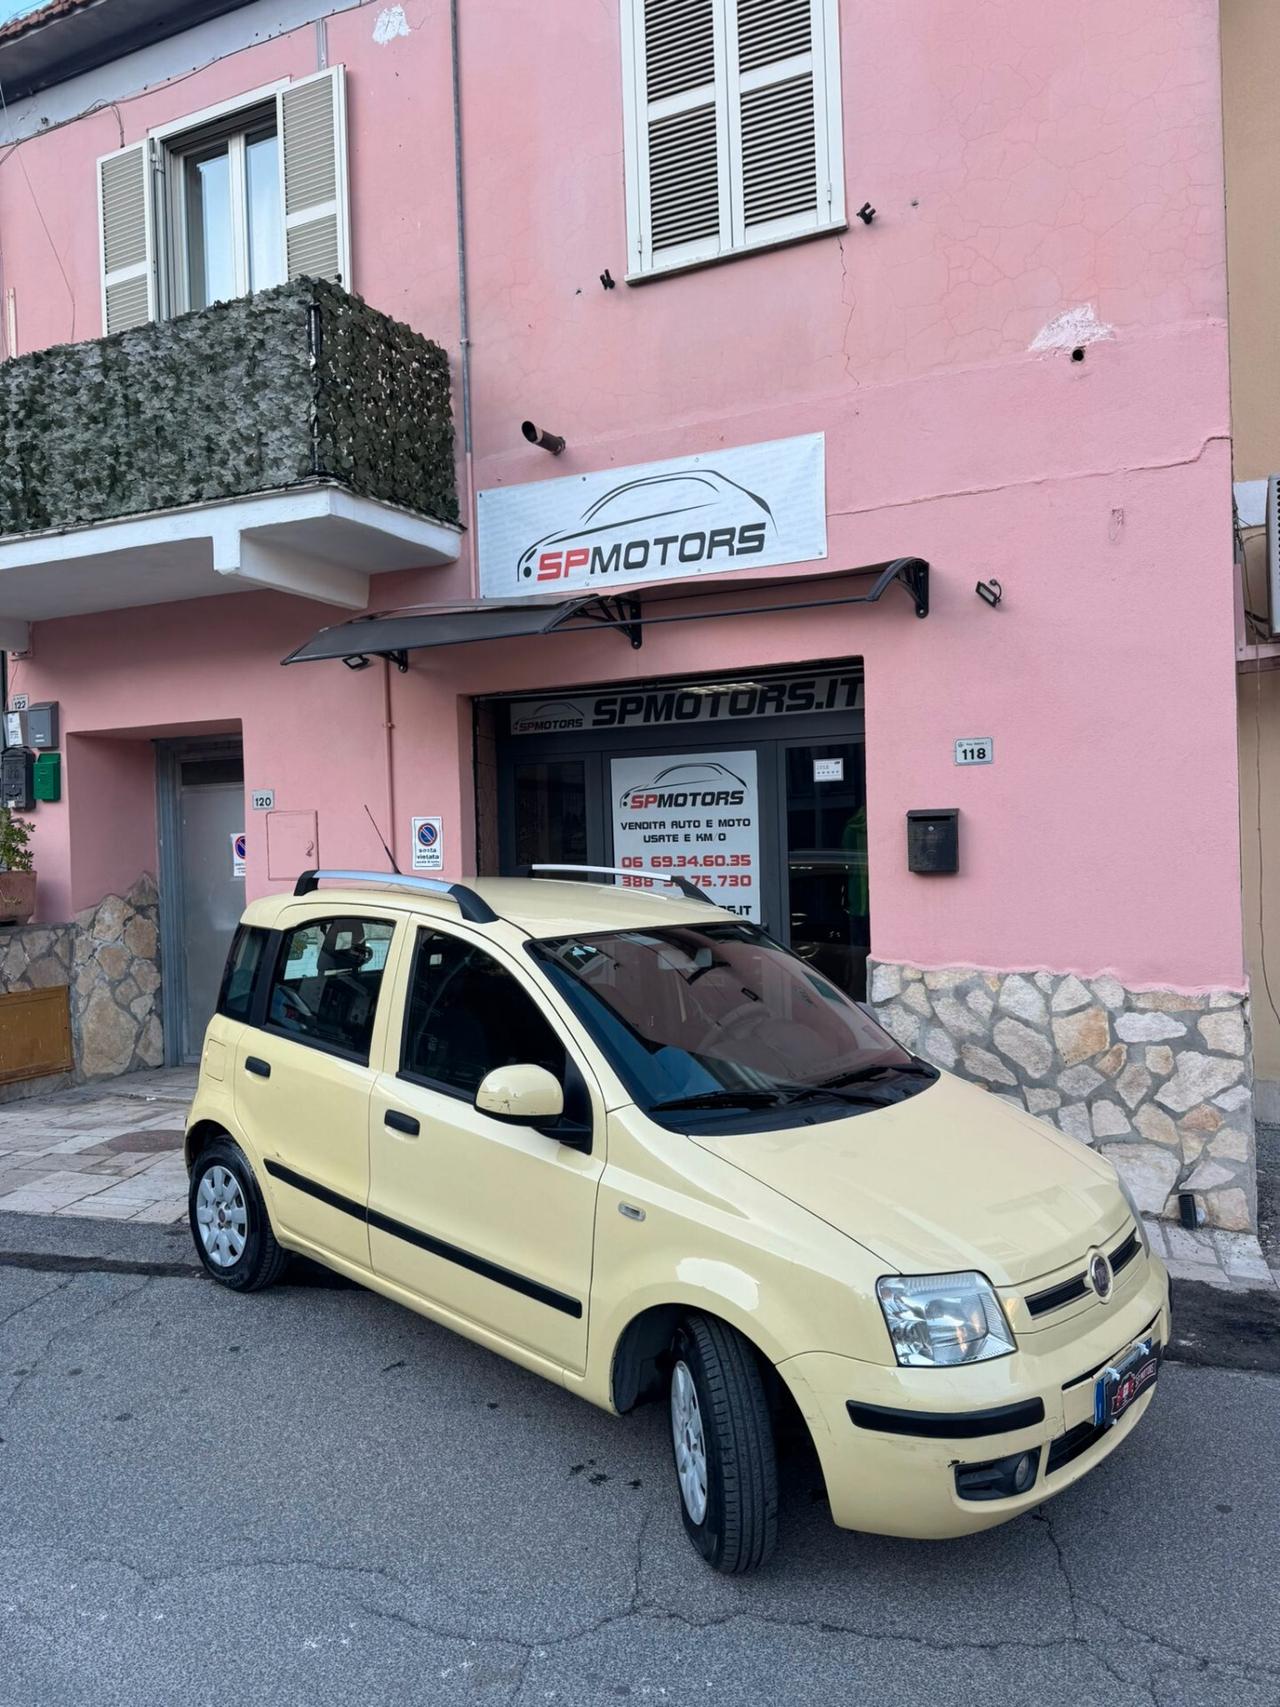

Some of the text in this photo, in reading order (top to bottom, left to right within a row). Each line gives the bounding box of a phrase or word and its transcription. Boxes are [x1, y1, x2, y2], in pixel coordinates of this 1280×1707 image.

[537, 522, 766, 581] SPMOTORS
[592, 678, 864, 727] SPMOTORS.IT
[962, 747, 986, 760] 118
[255, 797, 272, 807] 120
[630, 790, 744, 809] SPMOTORS
[620, 818, 751, 830] VENDITA AUTO E MOTO
[643, 834, 679, 843] USATE
[684, 833, 691, 842] E
[622, 854, 752, 868] 06 69.34.60.35
